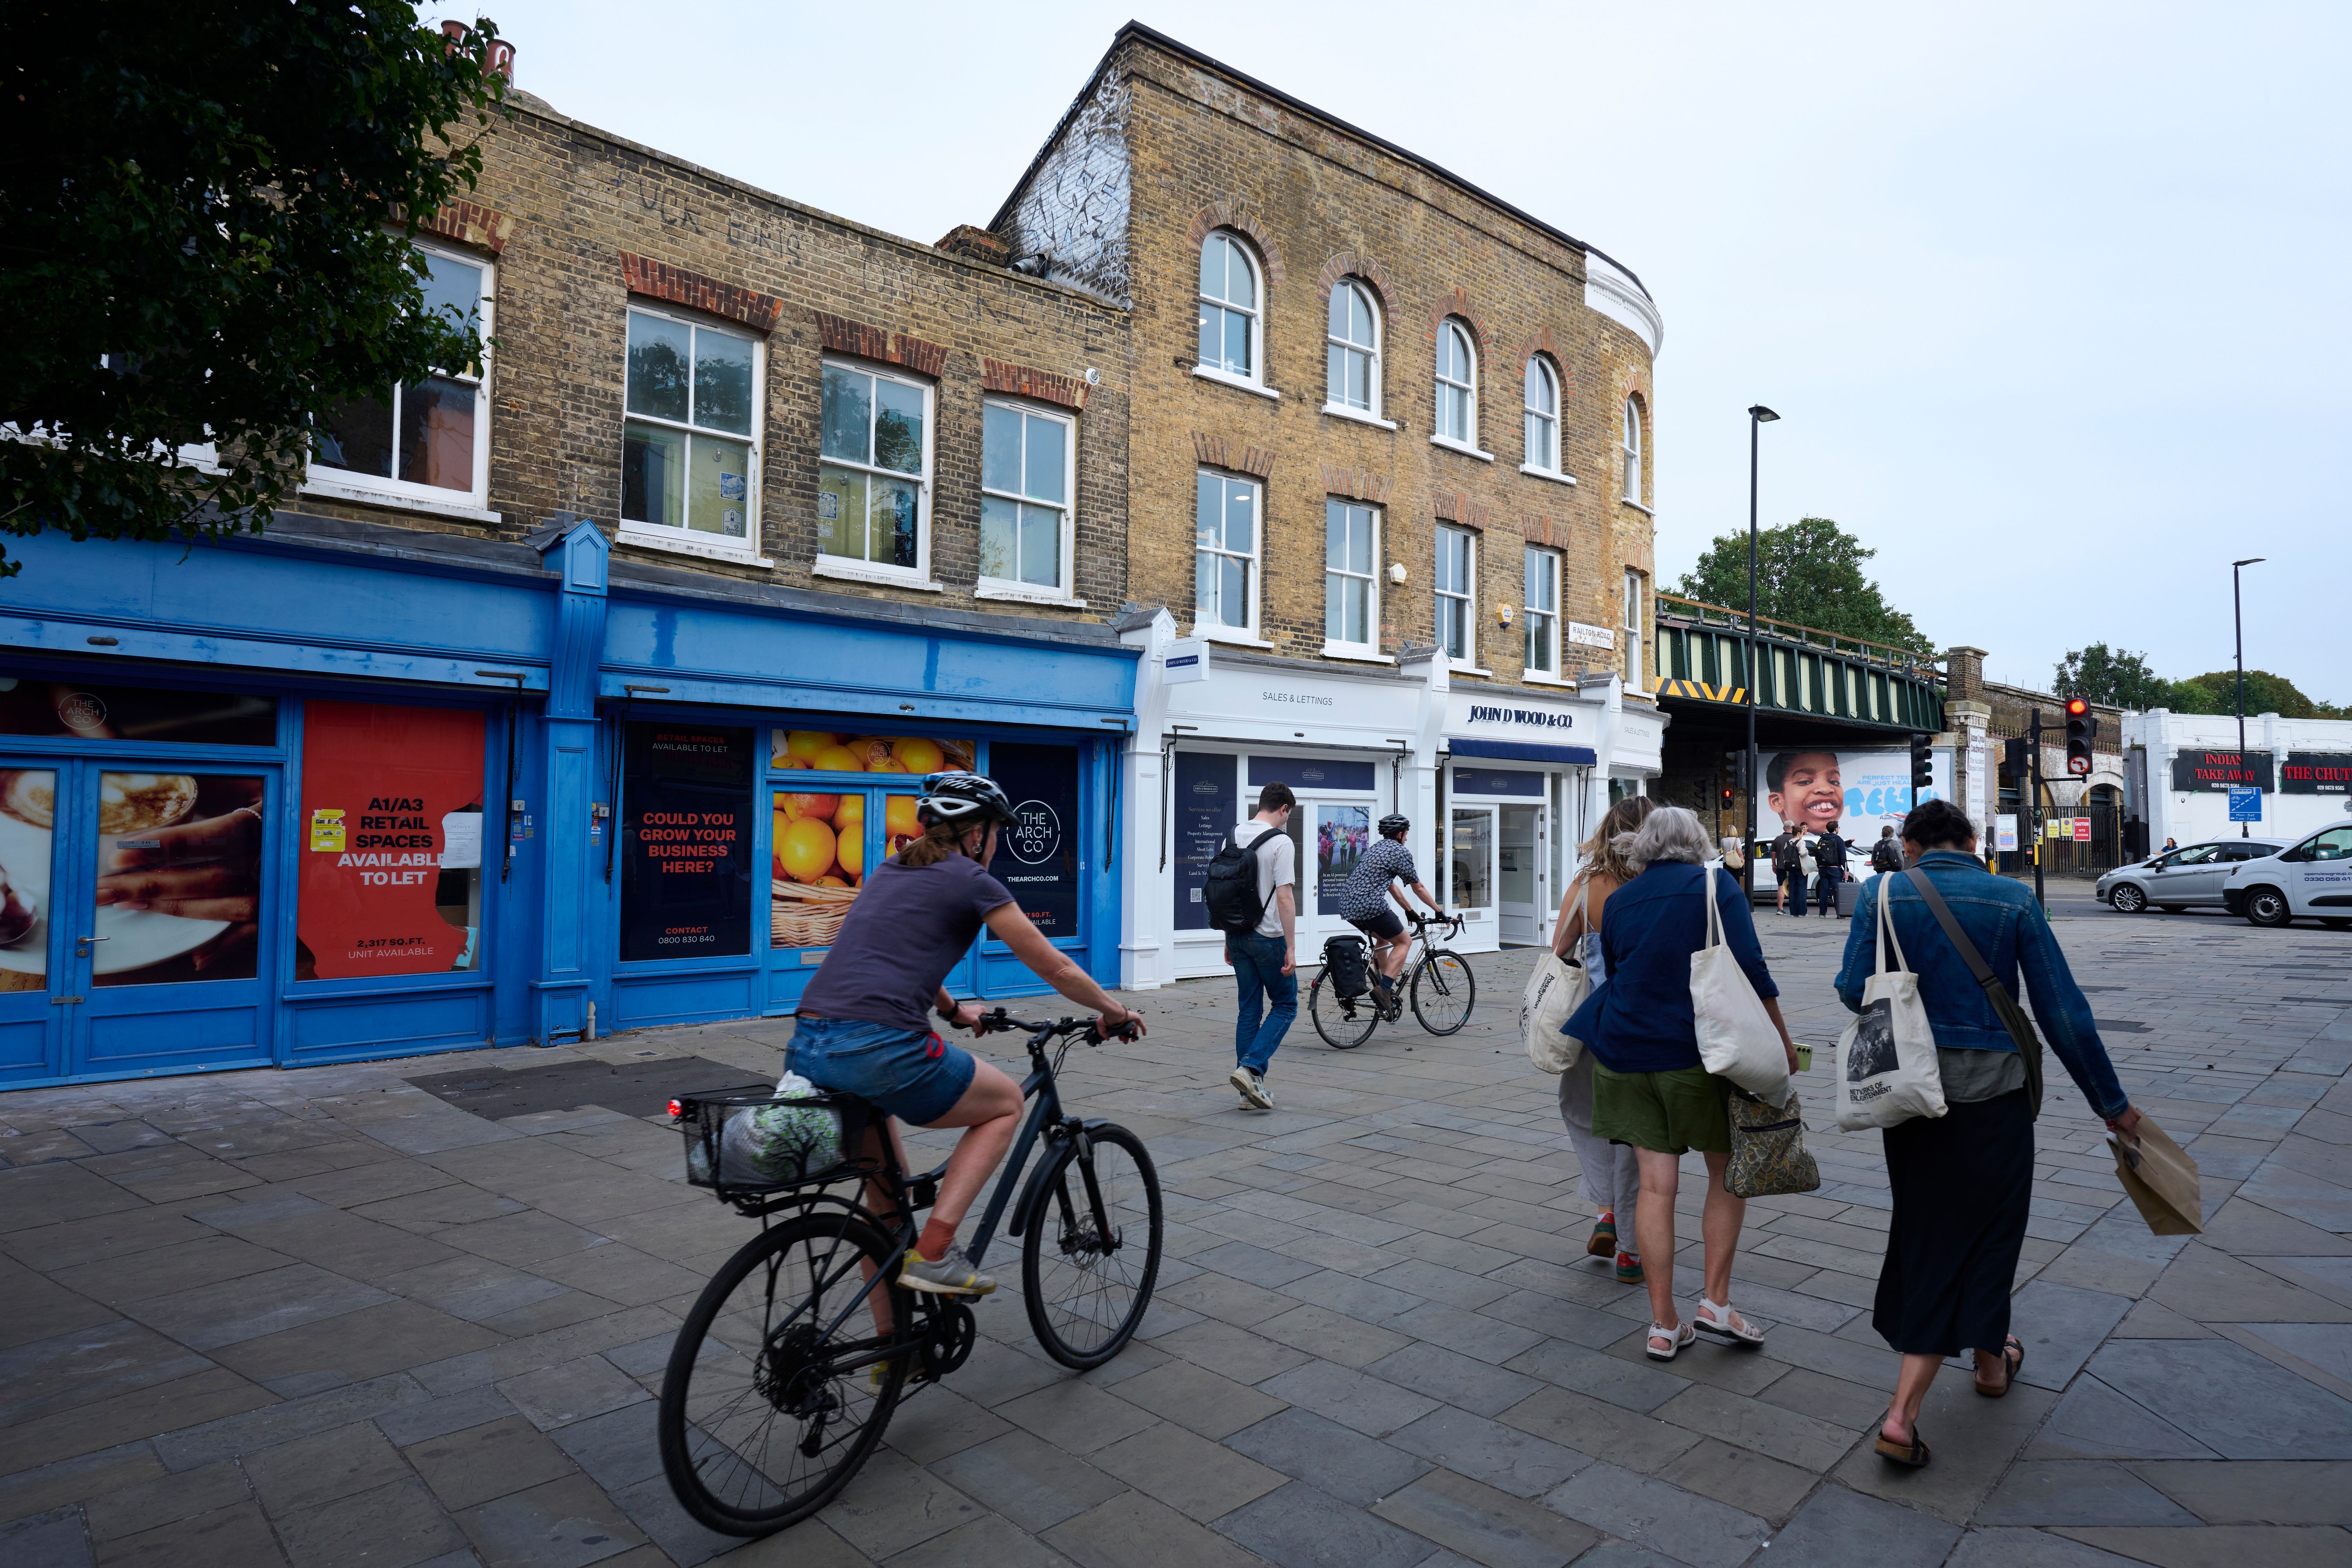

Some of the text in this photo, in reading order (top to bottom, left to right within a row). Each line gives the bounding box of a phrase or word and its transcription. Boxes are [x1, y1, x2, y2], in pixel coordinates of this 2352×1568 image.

[1573, 627, 1610, 640] RAILTON ROAD
[72, 699, 94, 708] THE
[1263, 692, 1287, 701] SALES
[1297, 695, 1332, 706] LETTINGS
[67, 707, 99, 716] ARCH
[1468, 706, 1557, 726] JOHN D WOOD &
[657, 733, 725, 744] RETAIL SPACES
[652, 743, 697, 751] AVAILABLE
[2195, 769, 2225, 780] TAKE
[2284, 766, 2352, 780] THE CHUT
[368, 798, 423, 813] A1/A3
[361, 816, 430, 829] RETAIL
[643, 813, 734, 825] COULD YOU
[1021, 812, 1046, 825] THE
[639, 829, 736, 841] GROW YOUR
[1015, 826, 1052, 838] ARCH
[356, 835, 433, 848] SPACES
[1024, 840, 1044, 853] CO
[649, 845, 728, 857] BUSINESS
[662, 861, 714, 873] HERE?
[360, 872, 428, 885] TO LET
[666, 926, 708, 935] CONTACT
[358, 937, 425, 949] 2,317 SQ.FT.
[348, 947, 434, 959] UNIT AVAILABLE
[1538, 973, 1551, 995] Central
[1534, 975, 1555, 1009] Paddington
[1850, 1085, 1892, 1101] ENLIGHTENMENT
